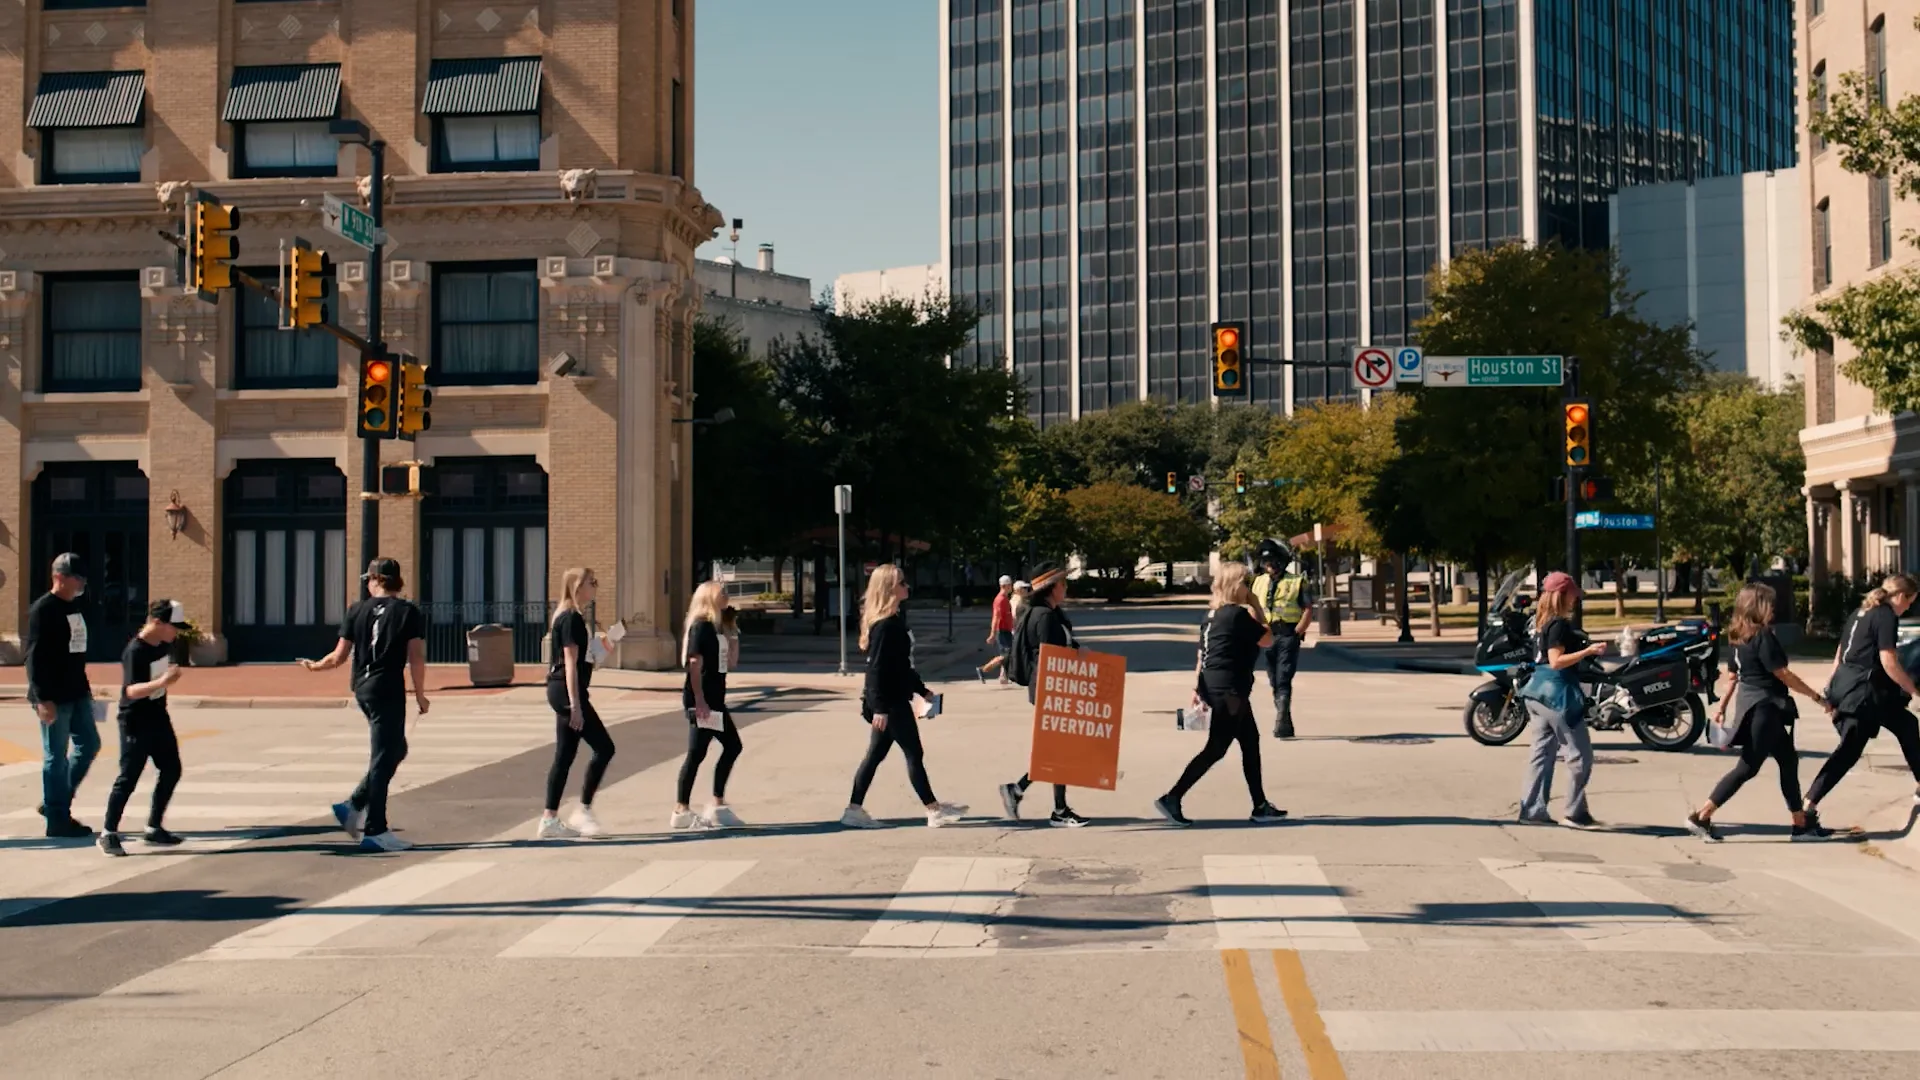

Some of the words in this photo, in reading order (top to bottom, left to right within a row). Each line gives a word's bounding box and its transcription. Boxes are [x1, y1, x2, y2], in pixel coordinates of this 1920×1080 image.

[1404, 352, 1416, 368] P
[1471, 359, 1534, 375] Houston
[1542, 359, 1557, 374] St
[1047, 656, 1098, 678] HUMAN
[1045, 676, 1097, 697] BEINGS
[1643, 681, 1671, 694] POLICE
[1043, 695, 1071, 713] ARE
[1075, 700, 1112, 719] SOLD
[1041, 714, 1113, 739] EVERYDAY
